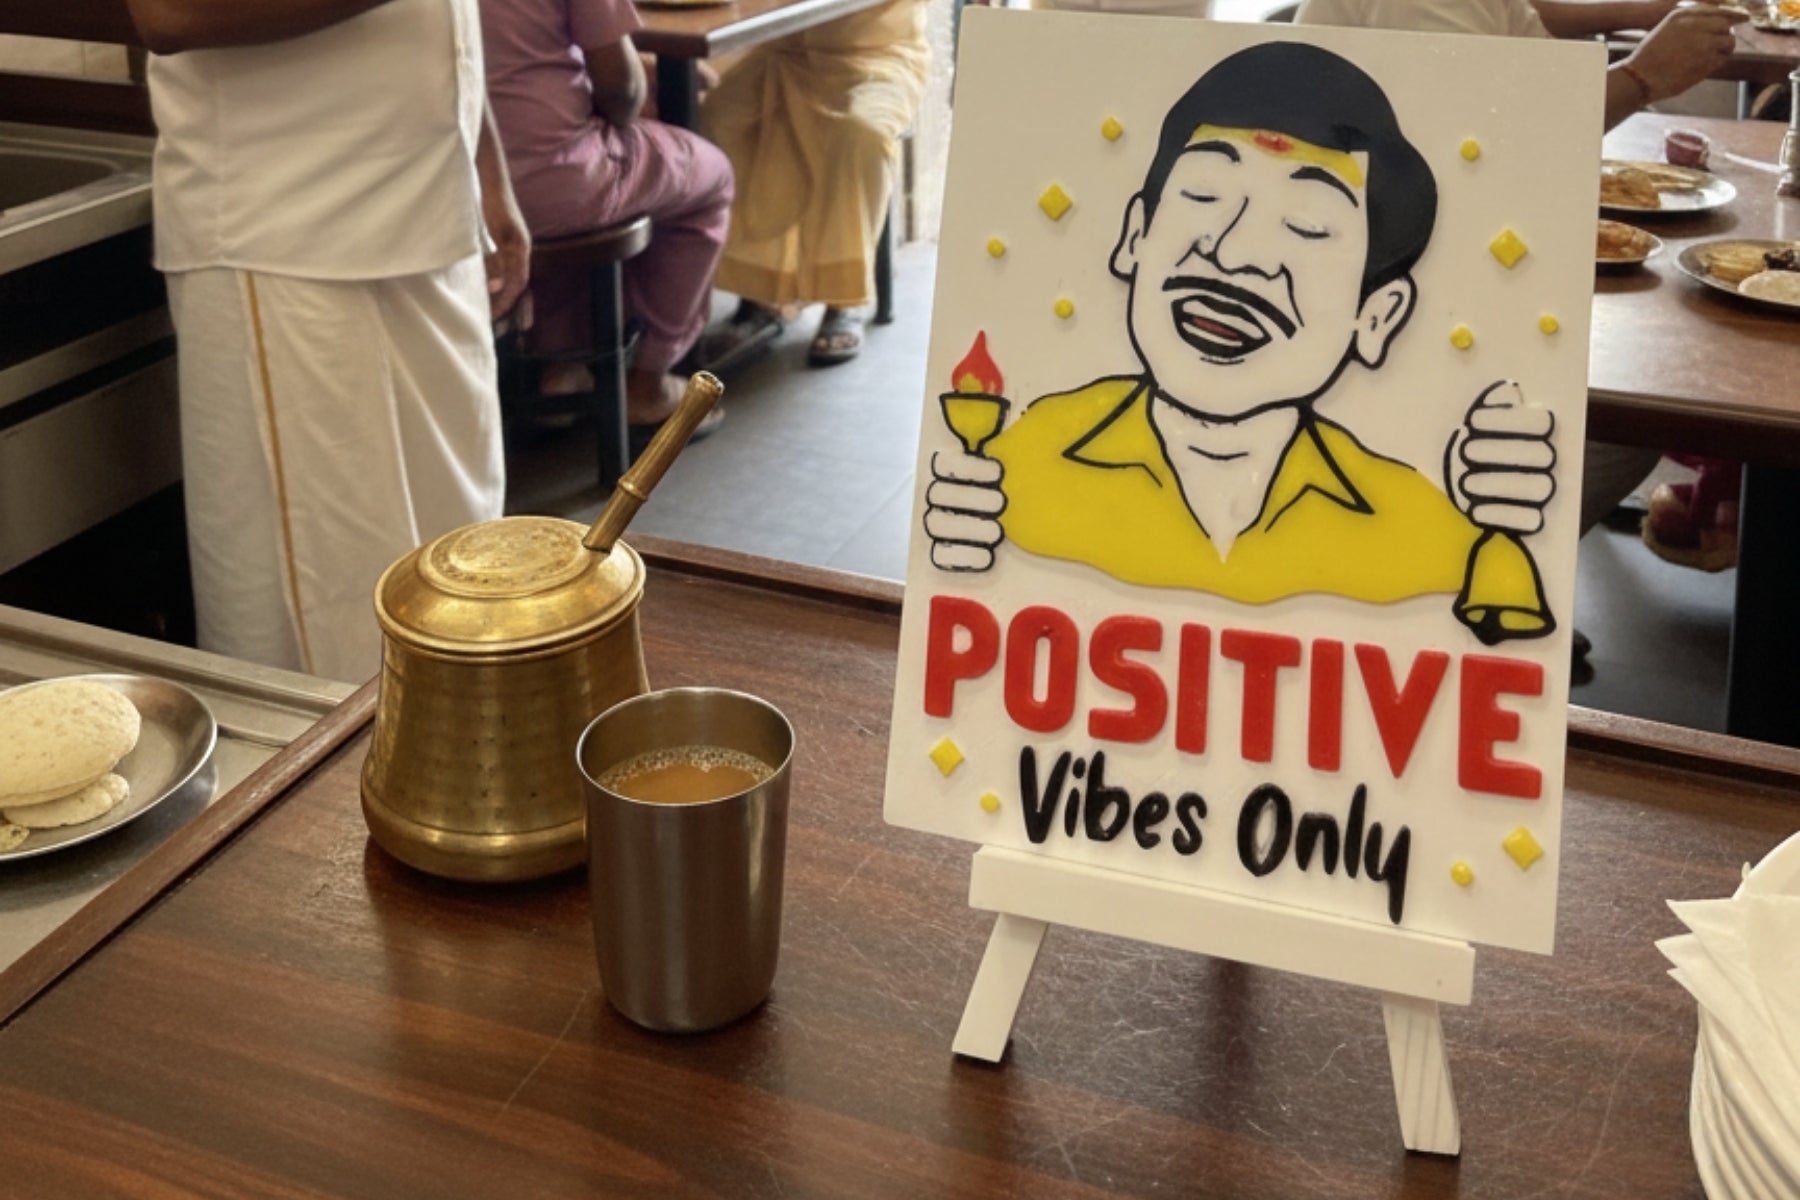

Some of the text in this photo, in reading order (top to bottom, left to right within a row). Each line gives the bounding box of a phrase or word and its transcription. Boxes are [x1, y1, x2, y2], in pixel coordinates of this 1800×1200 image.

[923, 594, 1545, 800] POSITIVE
[1019, 744, 1412, 925] Vibes Only
